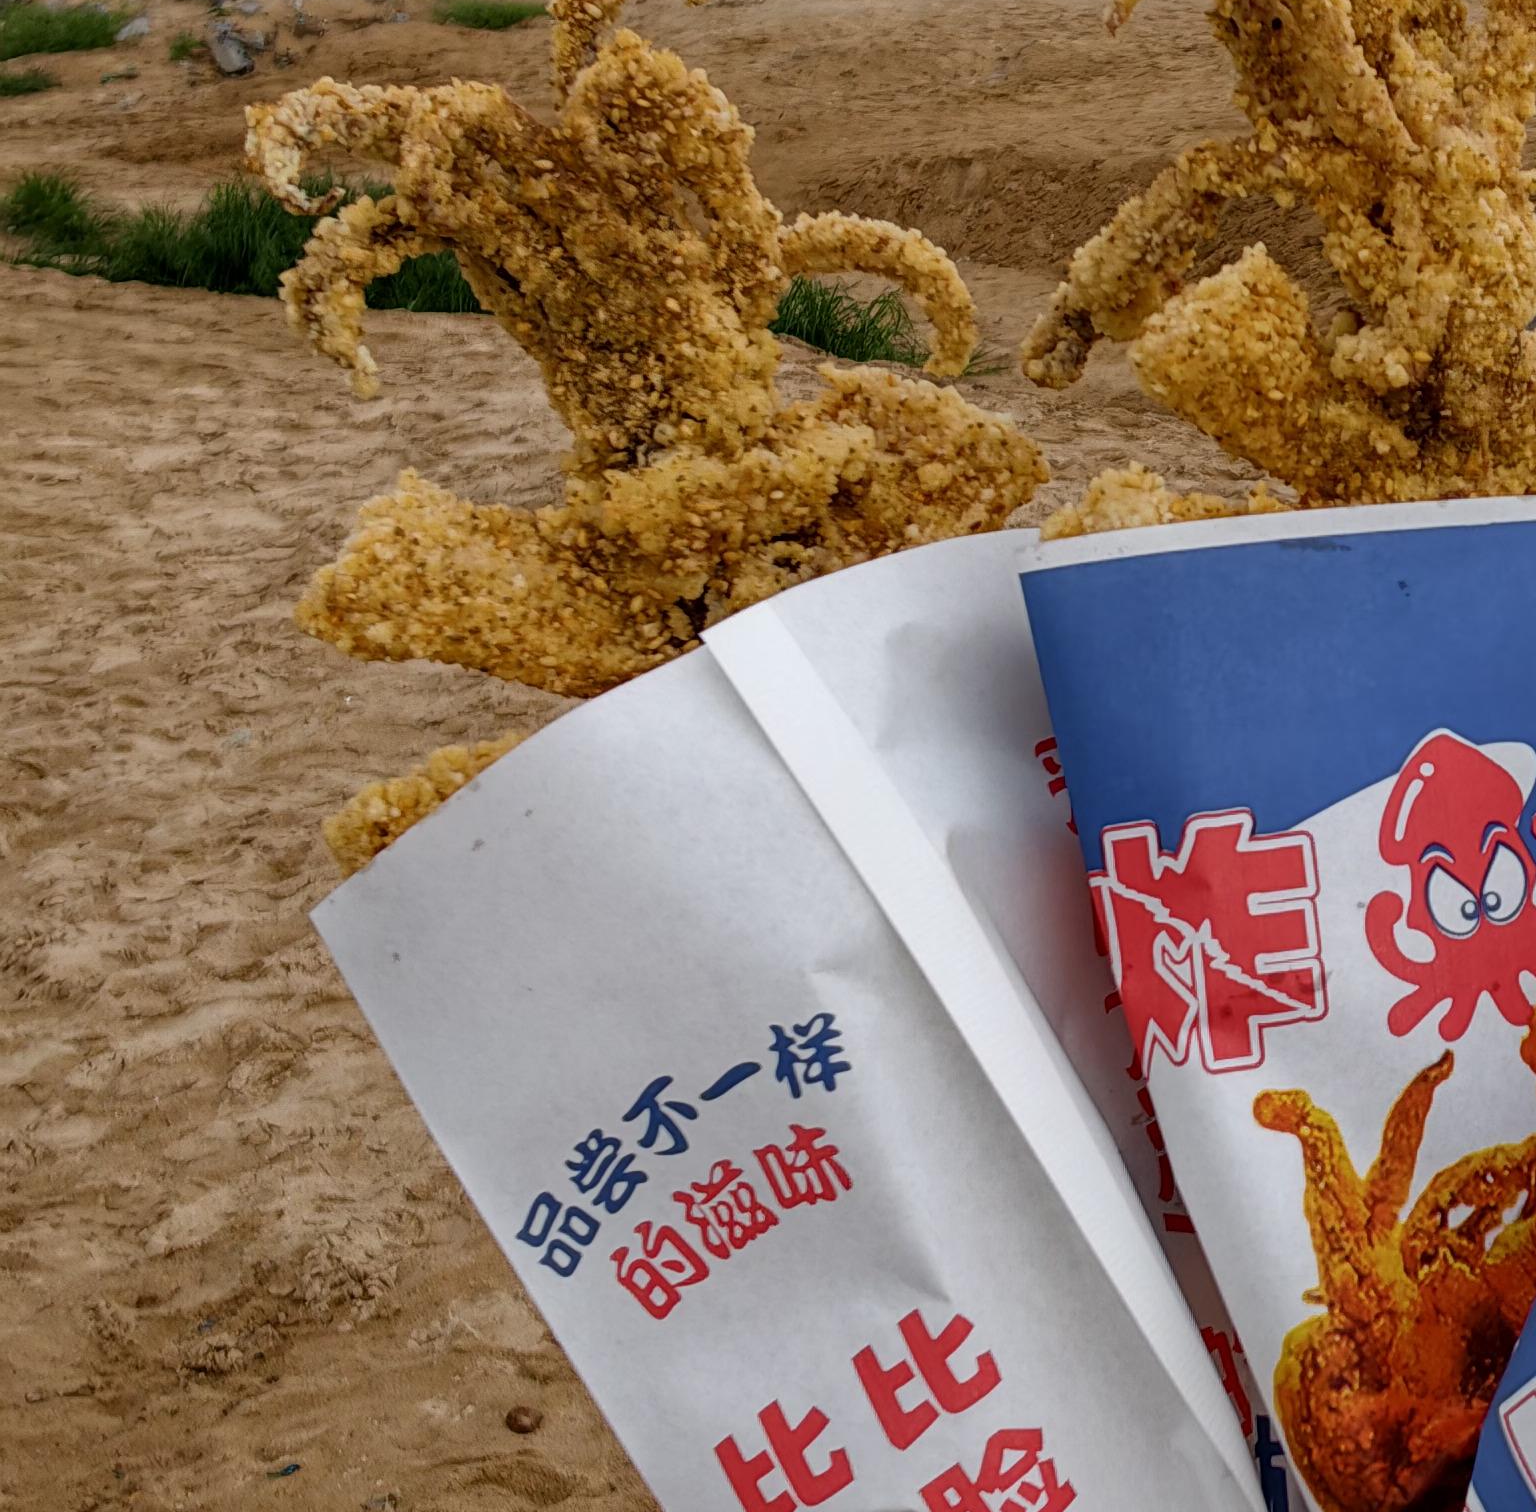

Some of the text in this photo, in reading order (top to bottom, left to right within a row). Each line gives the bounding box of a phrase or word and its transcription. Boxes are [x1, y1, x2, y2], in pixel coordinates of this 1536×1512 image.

[516, 1013, 852, 1279] 品尝不一样
[608, 1122, 854, 1321] 的滋味
